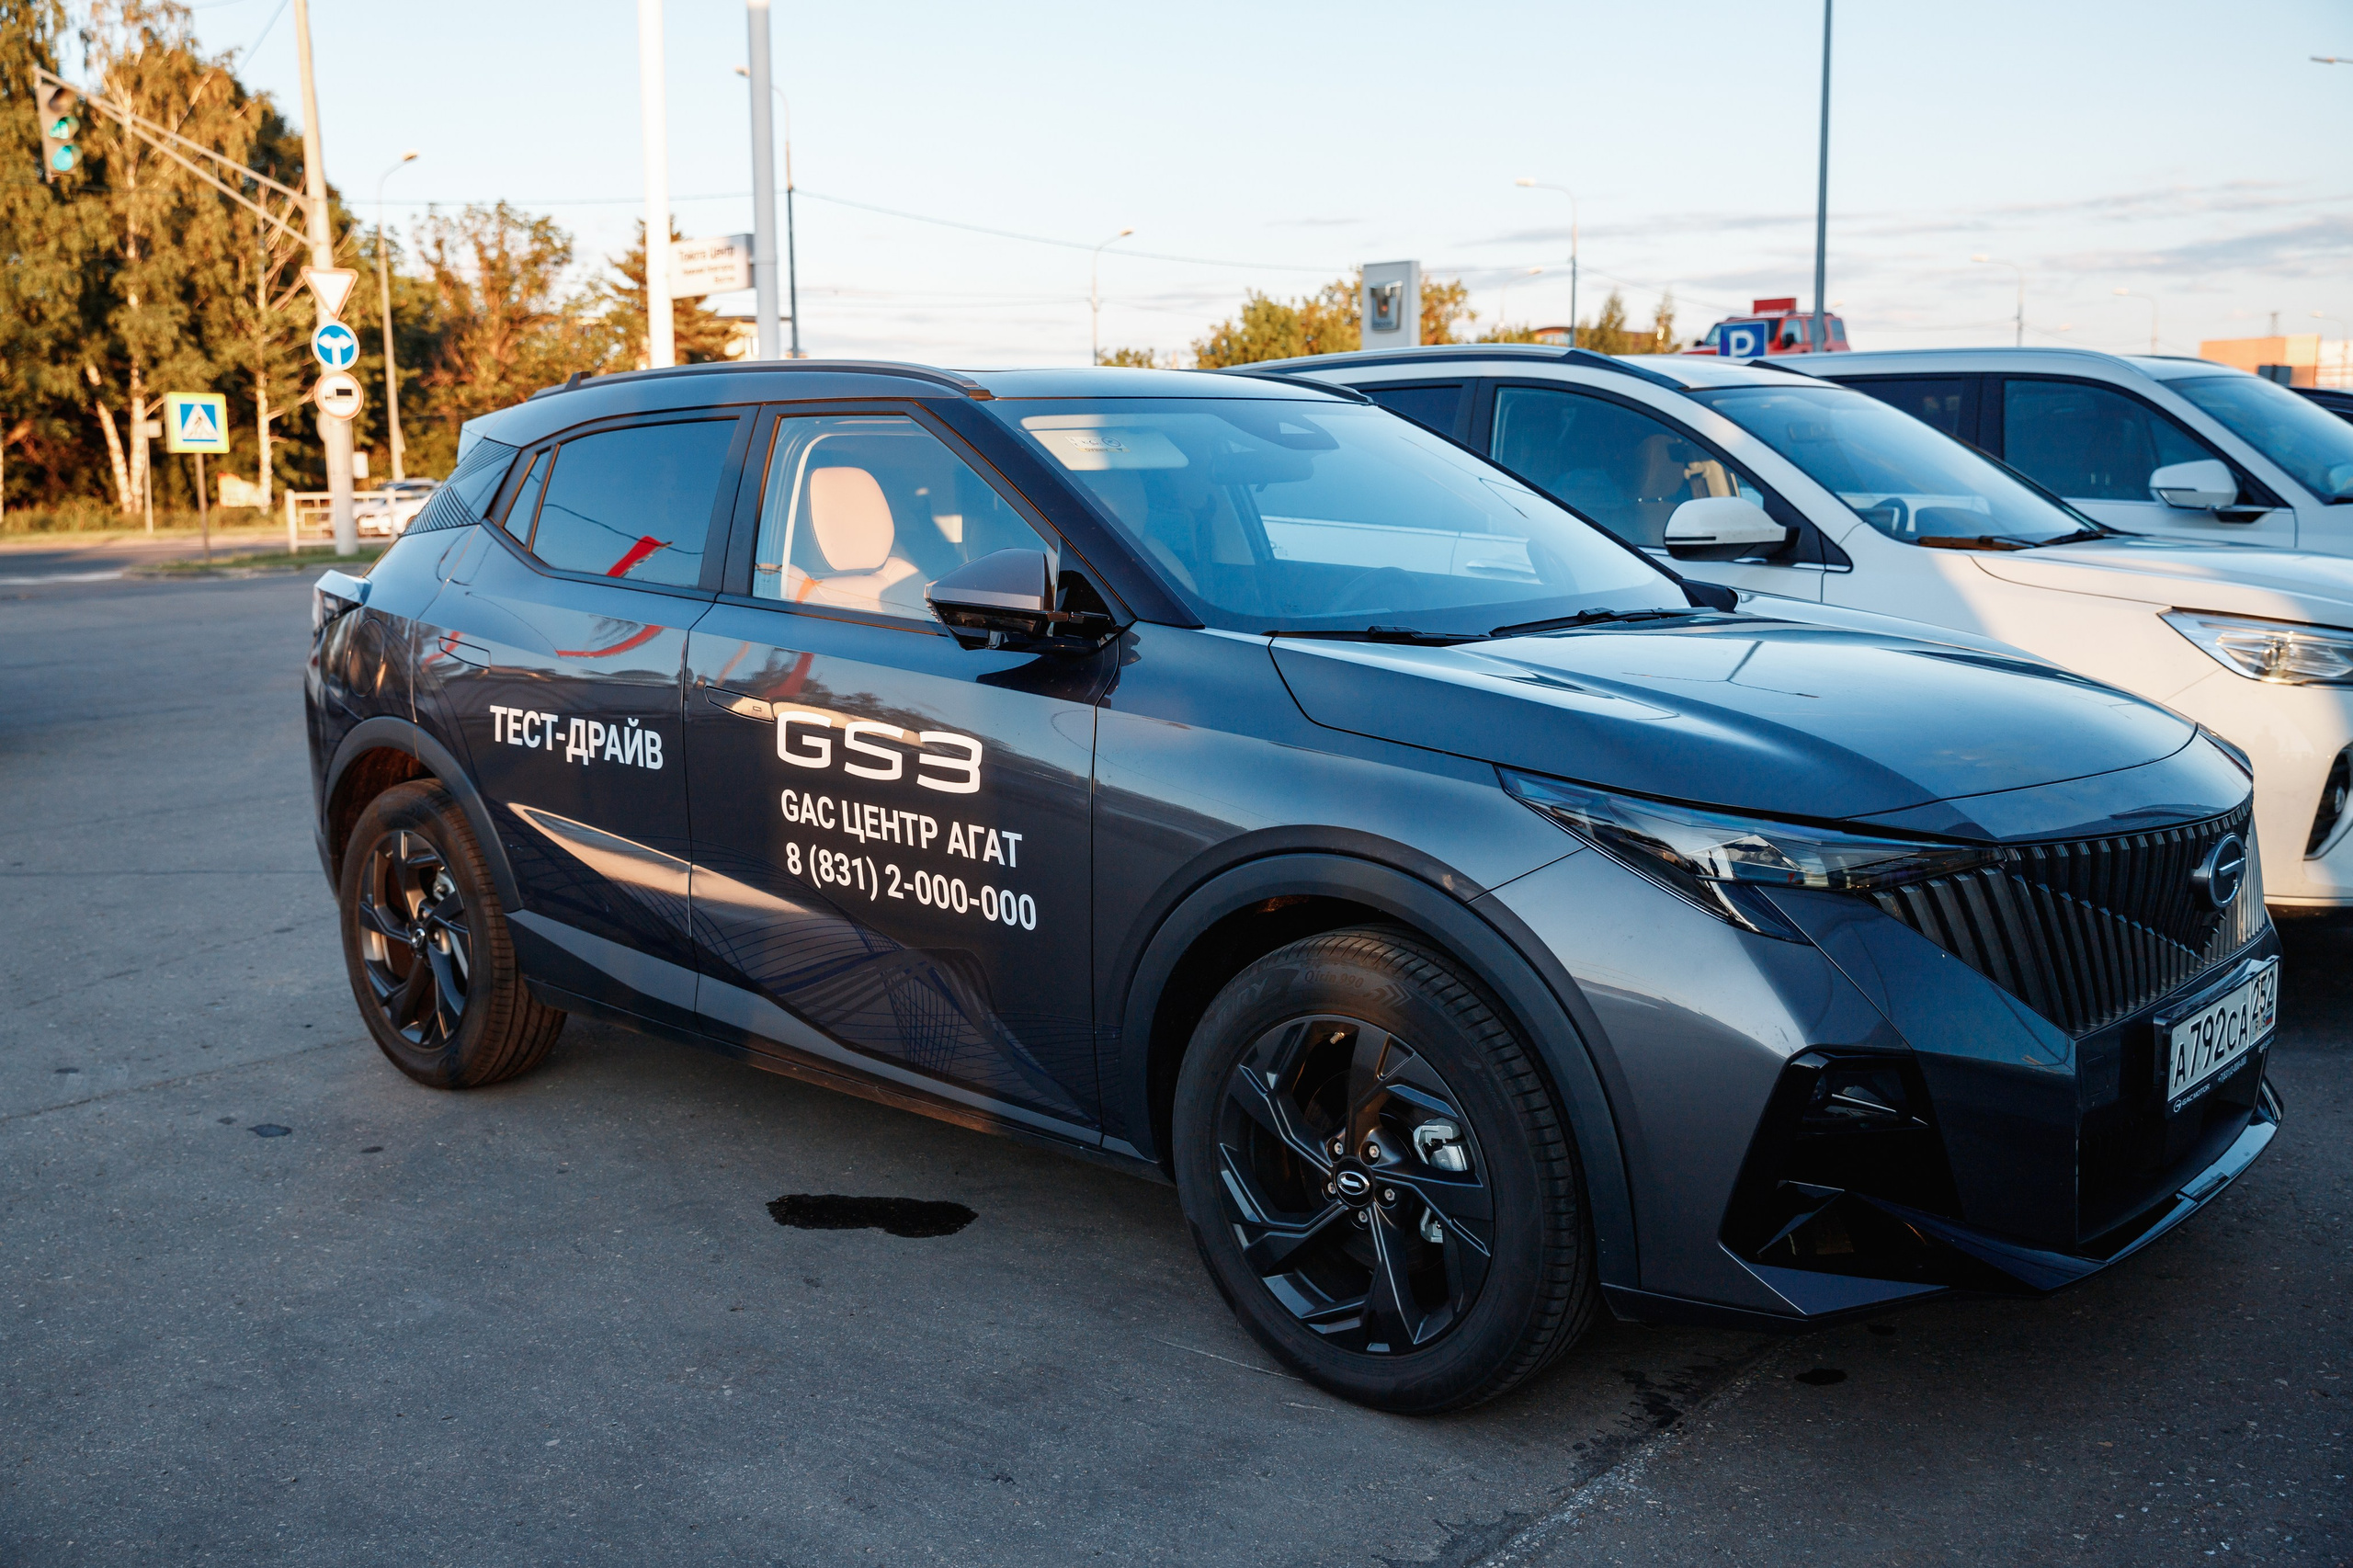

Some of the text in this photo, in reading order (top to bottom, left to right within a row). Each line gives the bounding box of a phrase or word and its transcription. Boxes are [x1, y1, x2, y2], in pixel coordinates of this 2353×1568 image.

[489, 705, 664, 770] ТЕСТ-ДРАЙВ
[776, 710, 983, 794] GS3
[780, 789, 1022, 869] GAC ЦЕНТР АГАТ
[786, 844, 1037, 931] 8 (831) 2-000-000
[1339, 971, 1364, 989] 990
[2252, 968, 2274, 1021] 252
